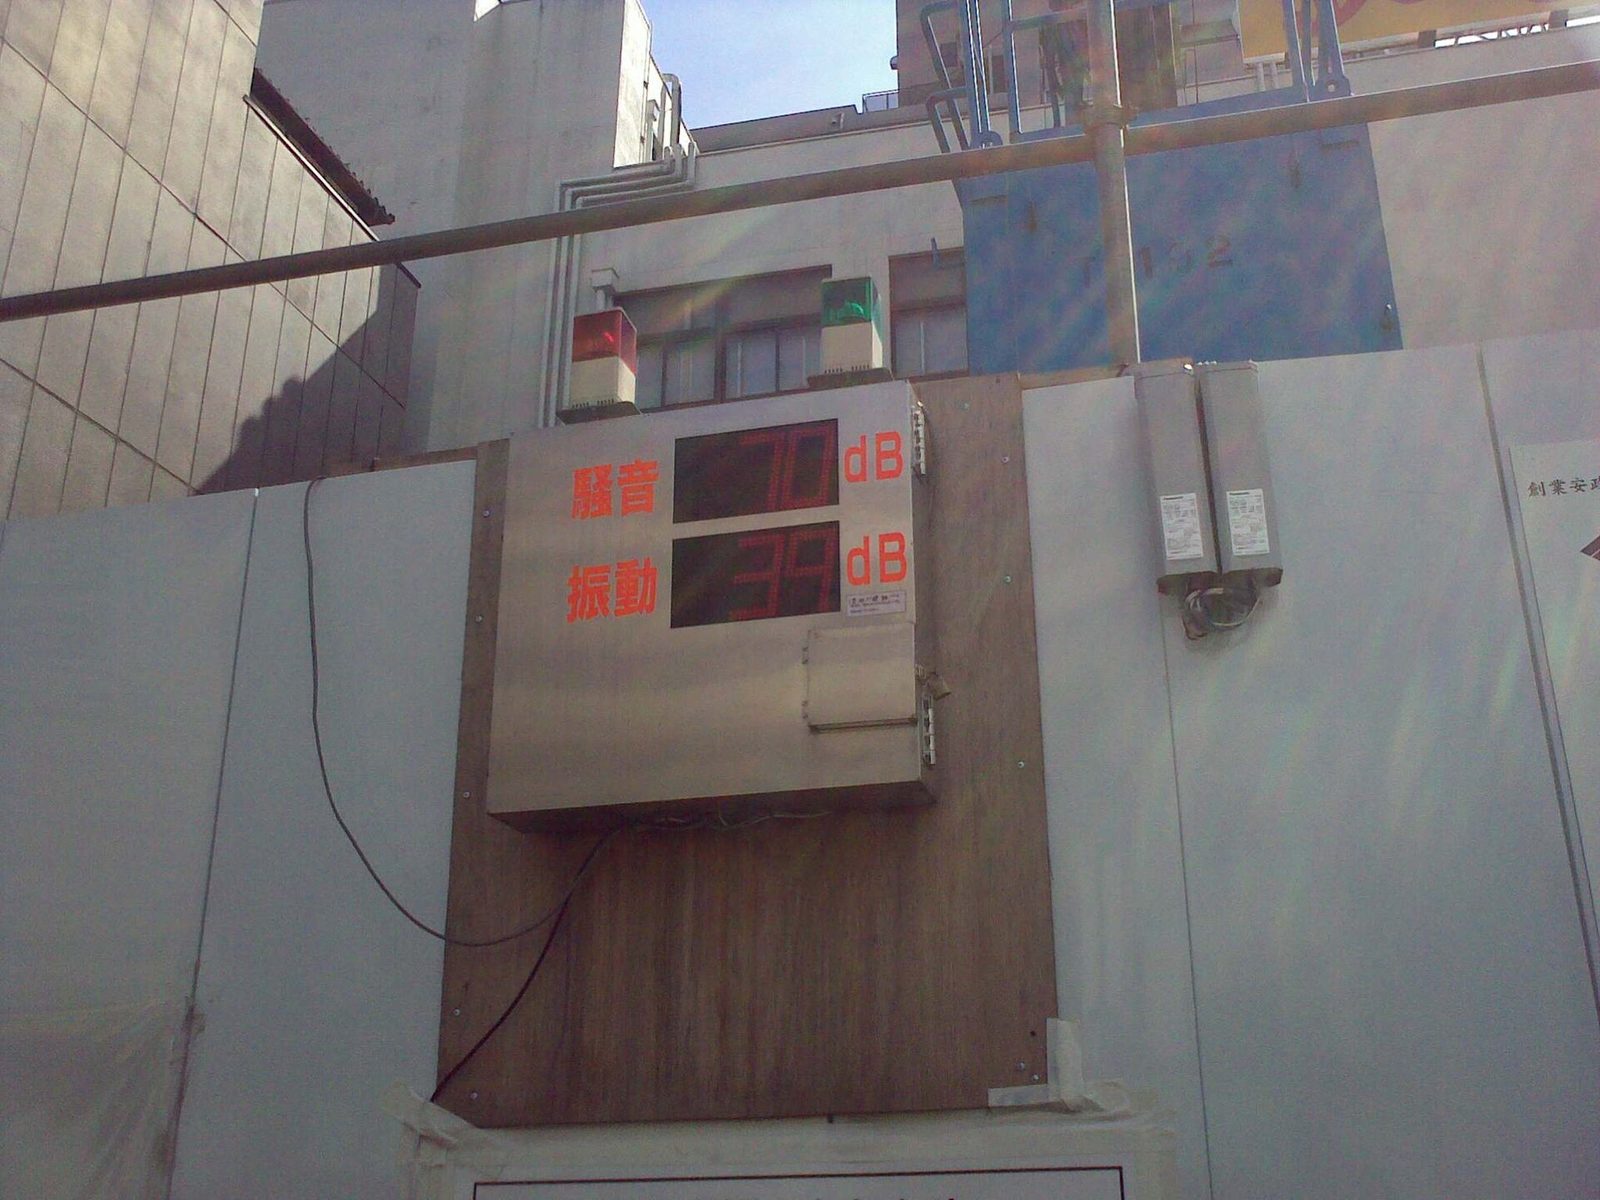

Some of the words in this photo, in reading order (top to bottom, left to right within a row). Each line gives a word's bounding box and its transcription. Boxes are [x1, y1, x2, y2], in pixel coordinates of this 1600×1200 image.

[571, 458, 660, 520] 騒音
[843, 431, 905, 484] dB
[565, 556, 659, 624] 振動
[846, 531, 908, 587] dB
